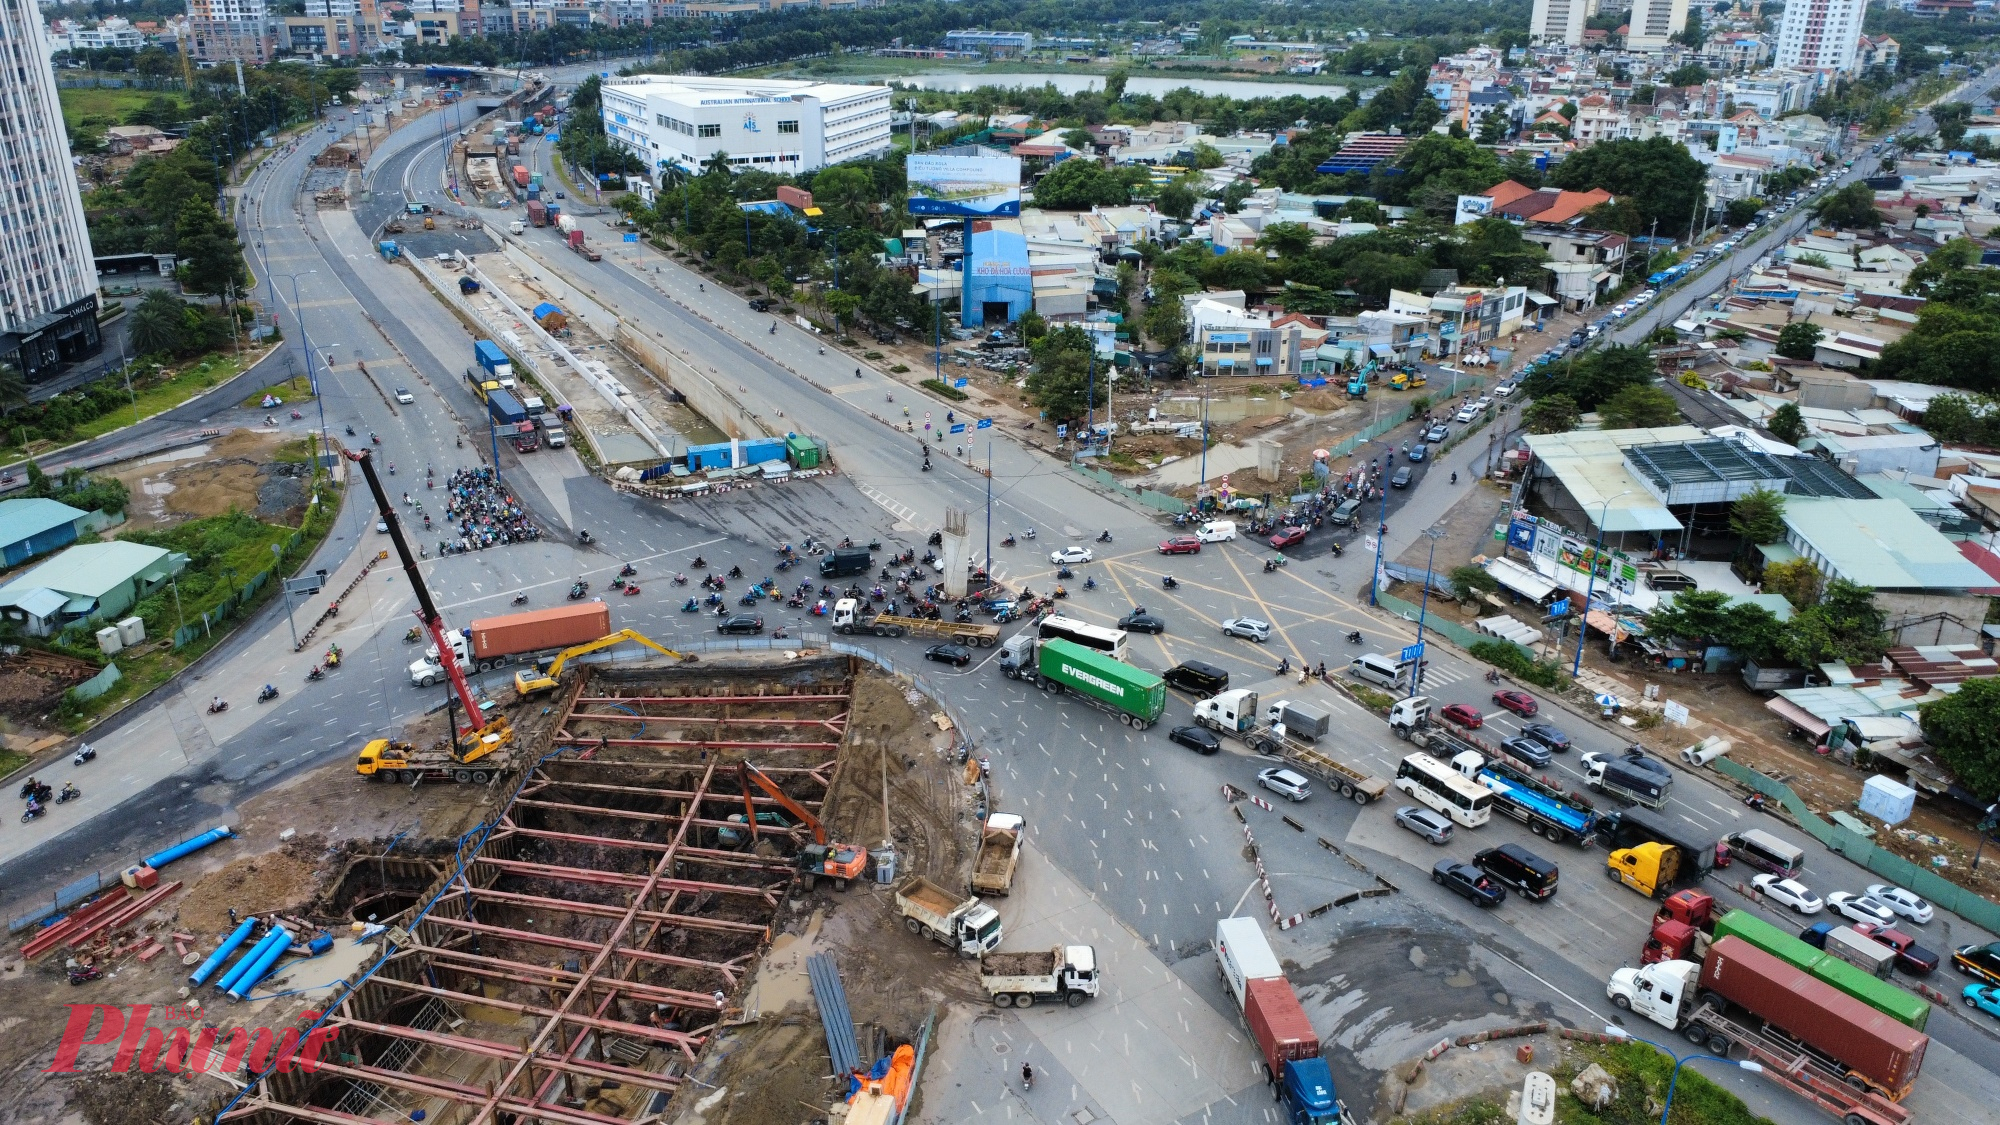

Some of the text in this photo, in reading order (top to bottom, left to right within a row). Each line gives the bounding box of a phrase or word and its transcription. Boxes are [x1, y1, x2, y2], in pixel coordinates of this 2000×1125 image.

[700, 98, 733, 106] AUSTRALIAN
[977, 267, 990, 275] KHO
[1000, 267, 1012, 275] HOA
[1544, 519, 1562, 532] TEIN
[1566, 529, 1575, 538] CAR
[439, 628, 452, 649] SANY
[1061, 663, 1125, 697] EVERGREEN
[1510, 795, 1535, 810] PETRO
